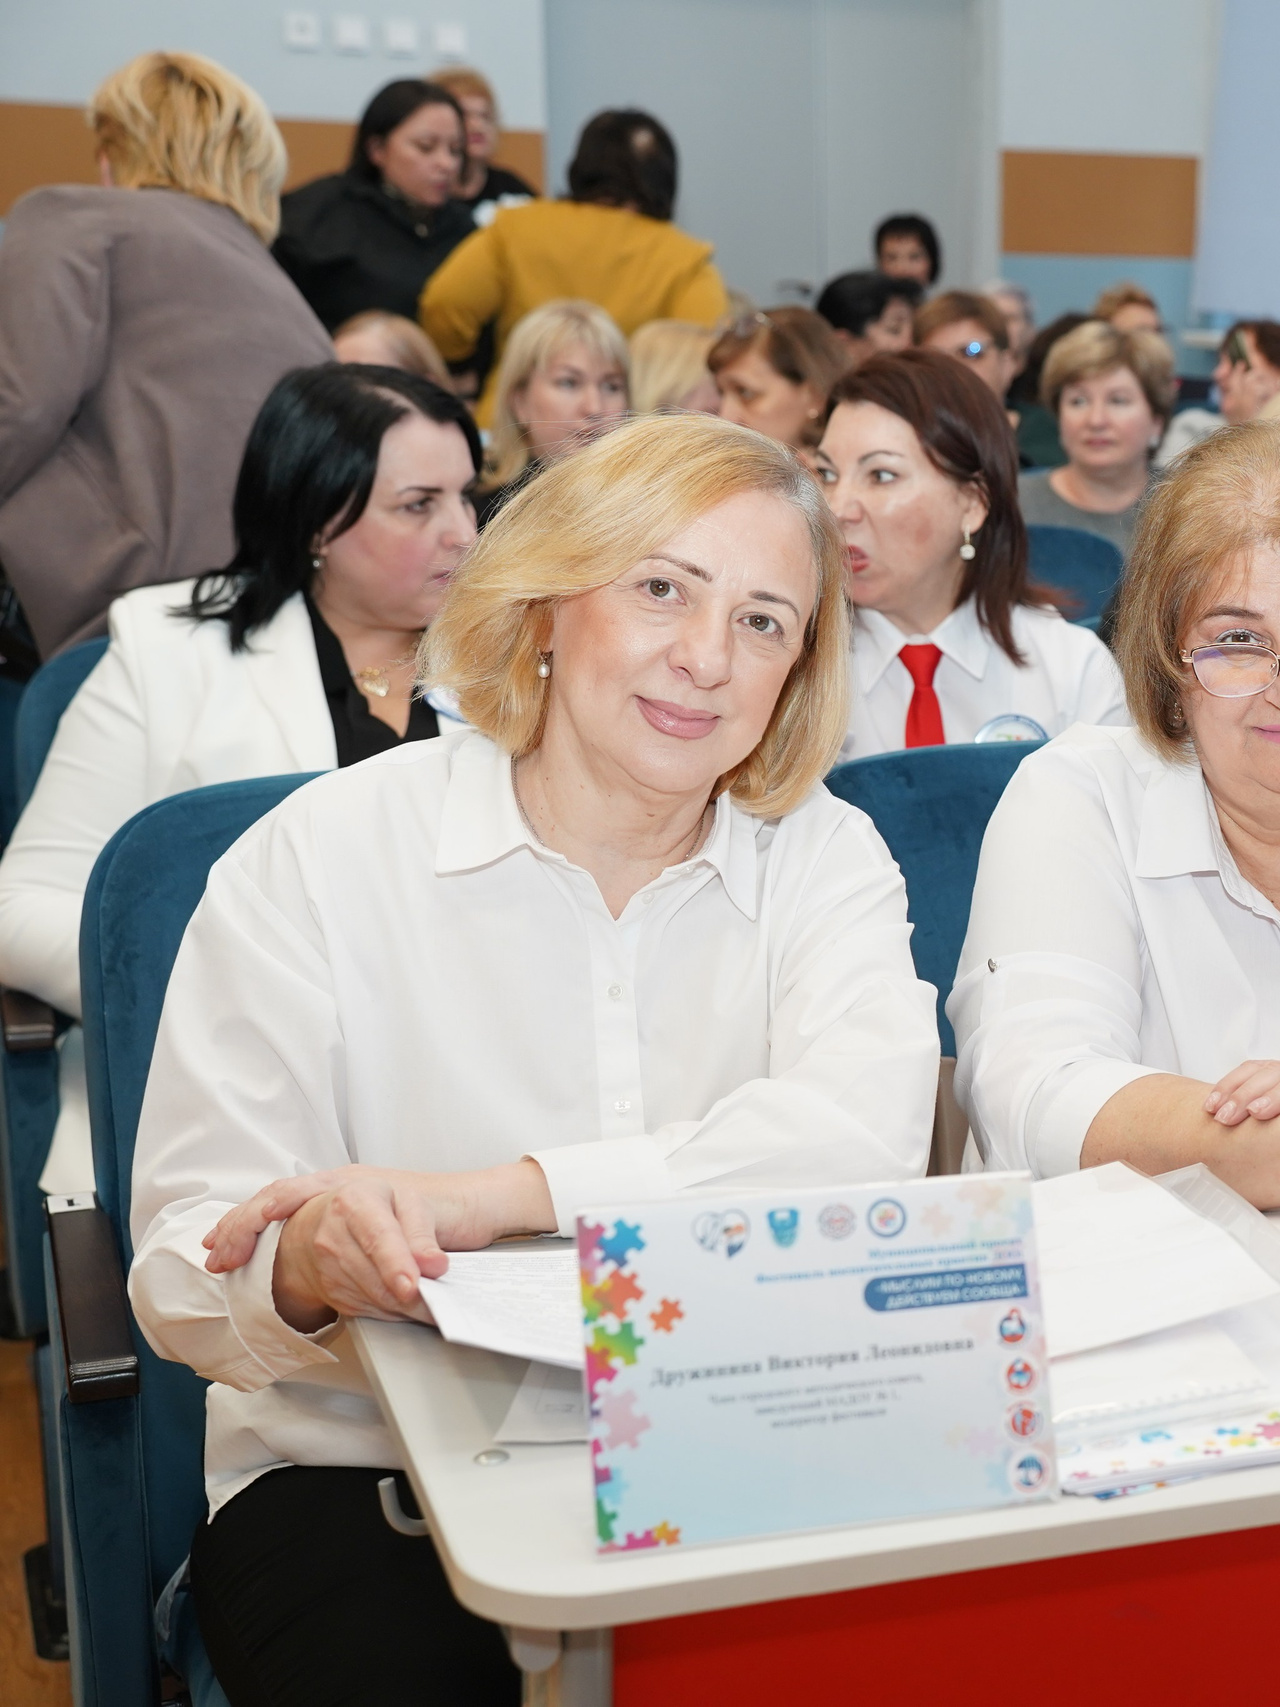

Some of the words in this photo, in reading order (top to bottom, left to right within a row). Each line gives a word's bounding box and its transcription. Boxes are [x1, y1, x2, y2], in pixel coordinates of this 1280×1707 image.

[885, 1289, 960, 1311] ДЕЙСТВУЕМ
[649, 1363, 762, 1388] Дружинина
[768, 1351, 860, 1373] Виктория
[865, 1338, 974, 1362] Леонидовна
